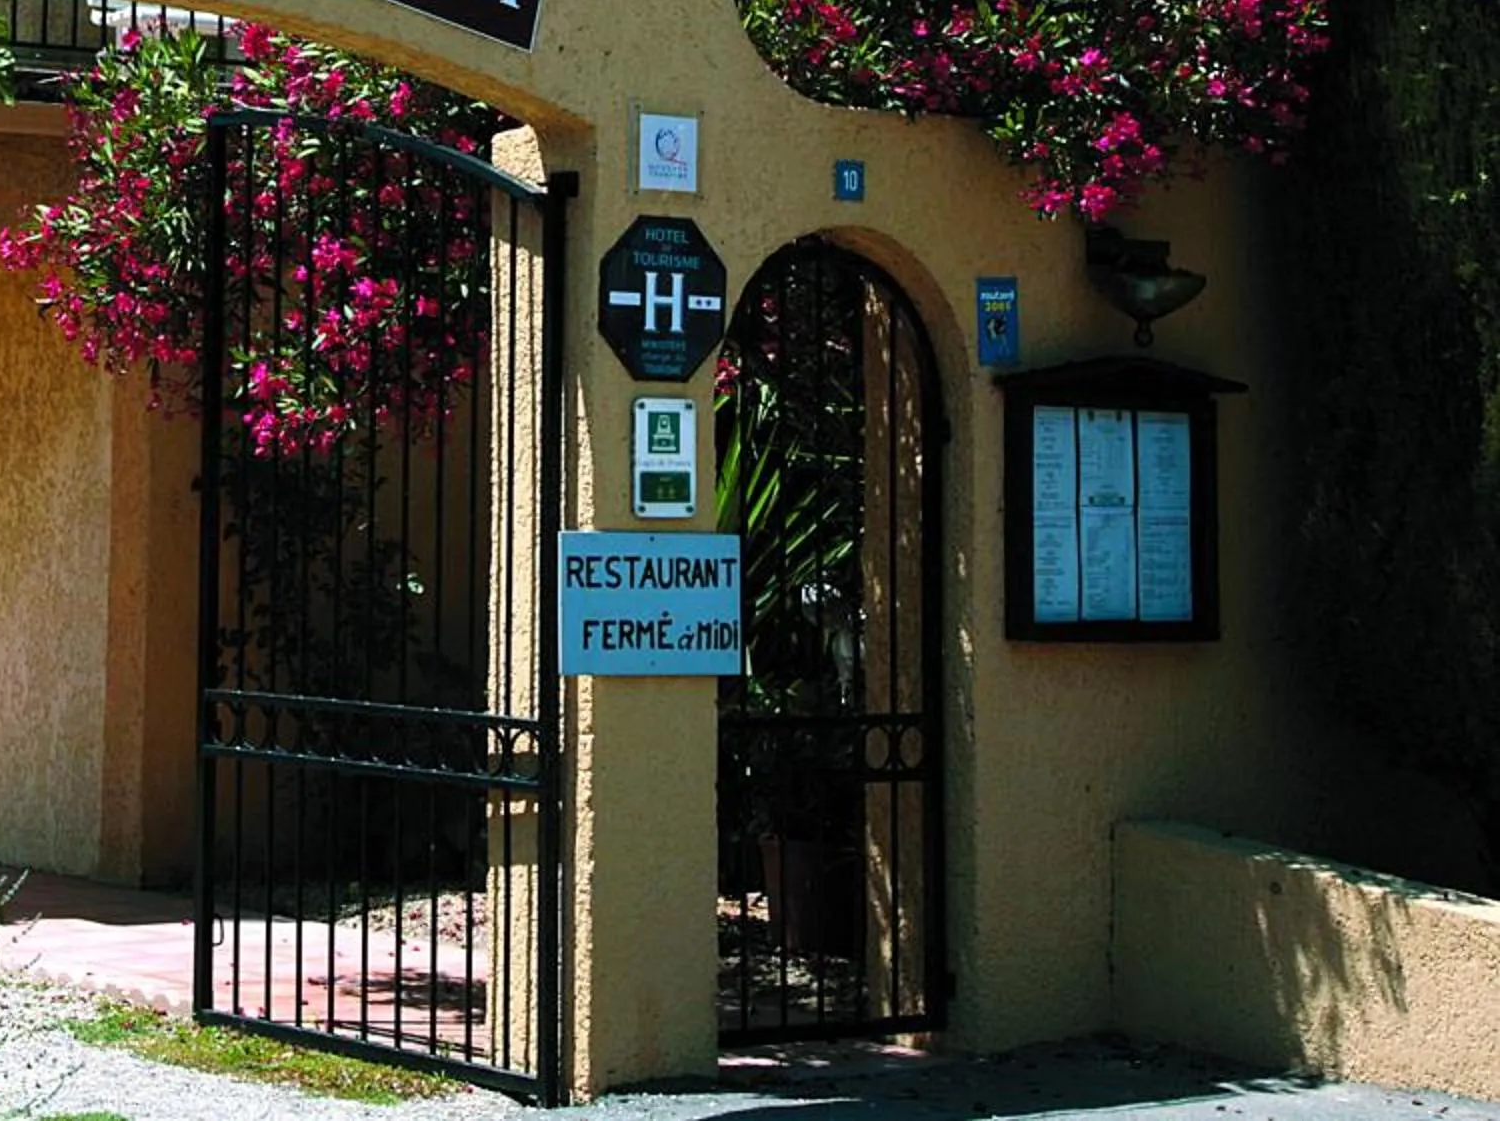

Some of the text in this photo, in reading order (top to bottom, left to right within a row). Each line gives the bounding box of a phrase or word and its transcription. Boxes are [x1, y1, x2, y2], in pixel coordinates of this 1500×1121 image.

[843, 169, 859, 192] 10
[644, 228, 690, 244] HOTEL
[632, 250, 702, 270] TOURISME
[644, 270, 685, 334] H
[565, 555, 737, 590] RESTAURANT
[582, 610, 675, 651] FERMÉ
